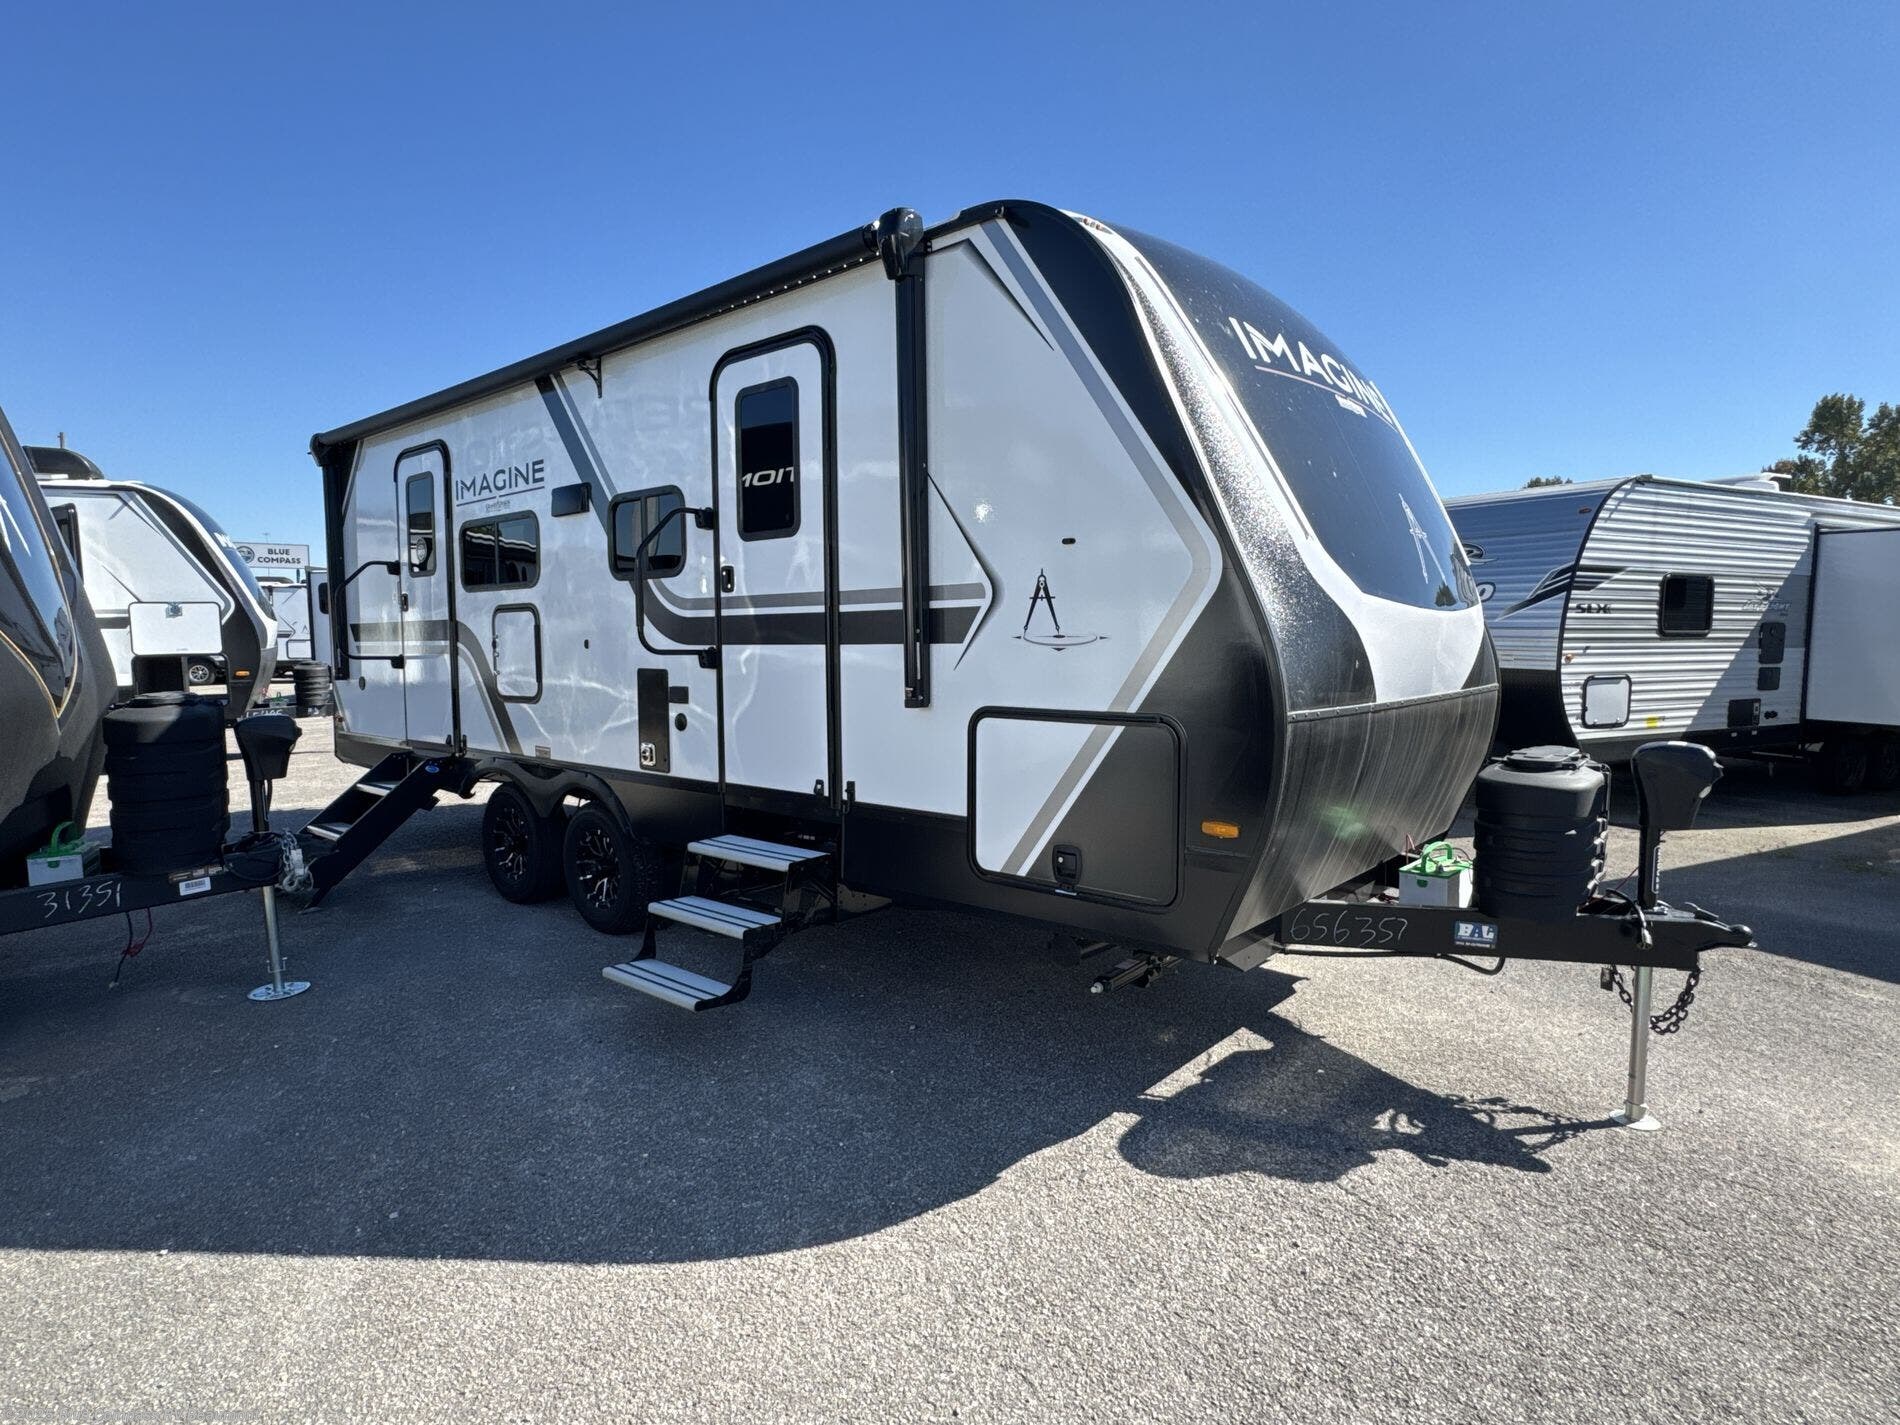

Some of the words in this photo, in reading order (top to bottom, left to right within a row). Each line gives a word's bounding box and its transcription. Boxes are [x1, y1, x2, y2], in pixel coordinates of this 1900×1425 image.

[455, 459, 545, 501] IMAGINE
[257, 556, 301, 564] COMPASS
[37, 881, 121, 918] 31351
[1291, 908, 1408, 946] 656357
